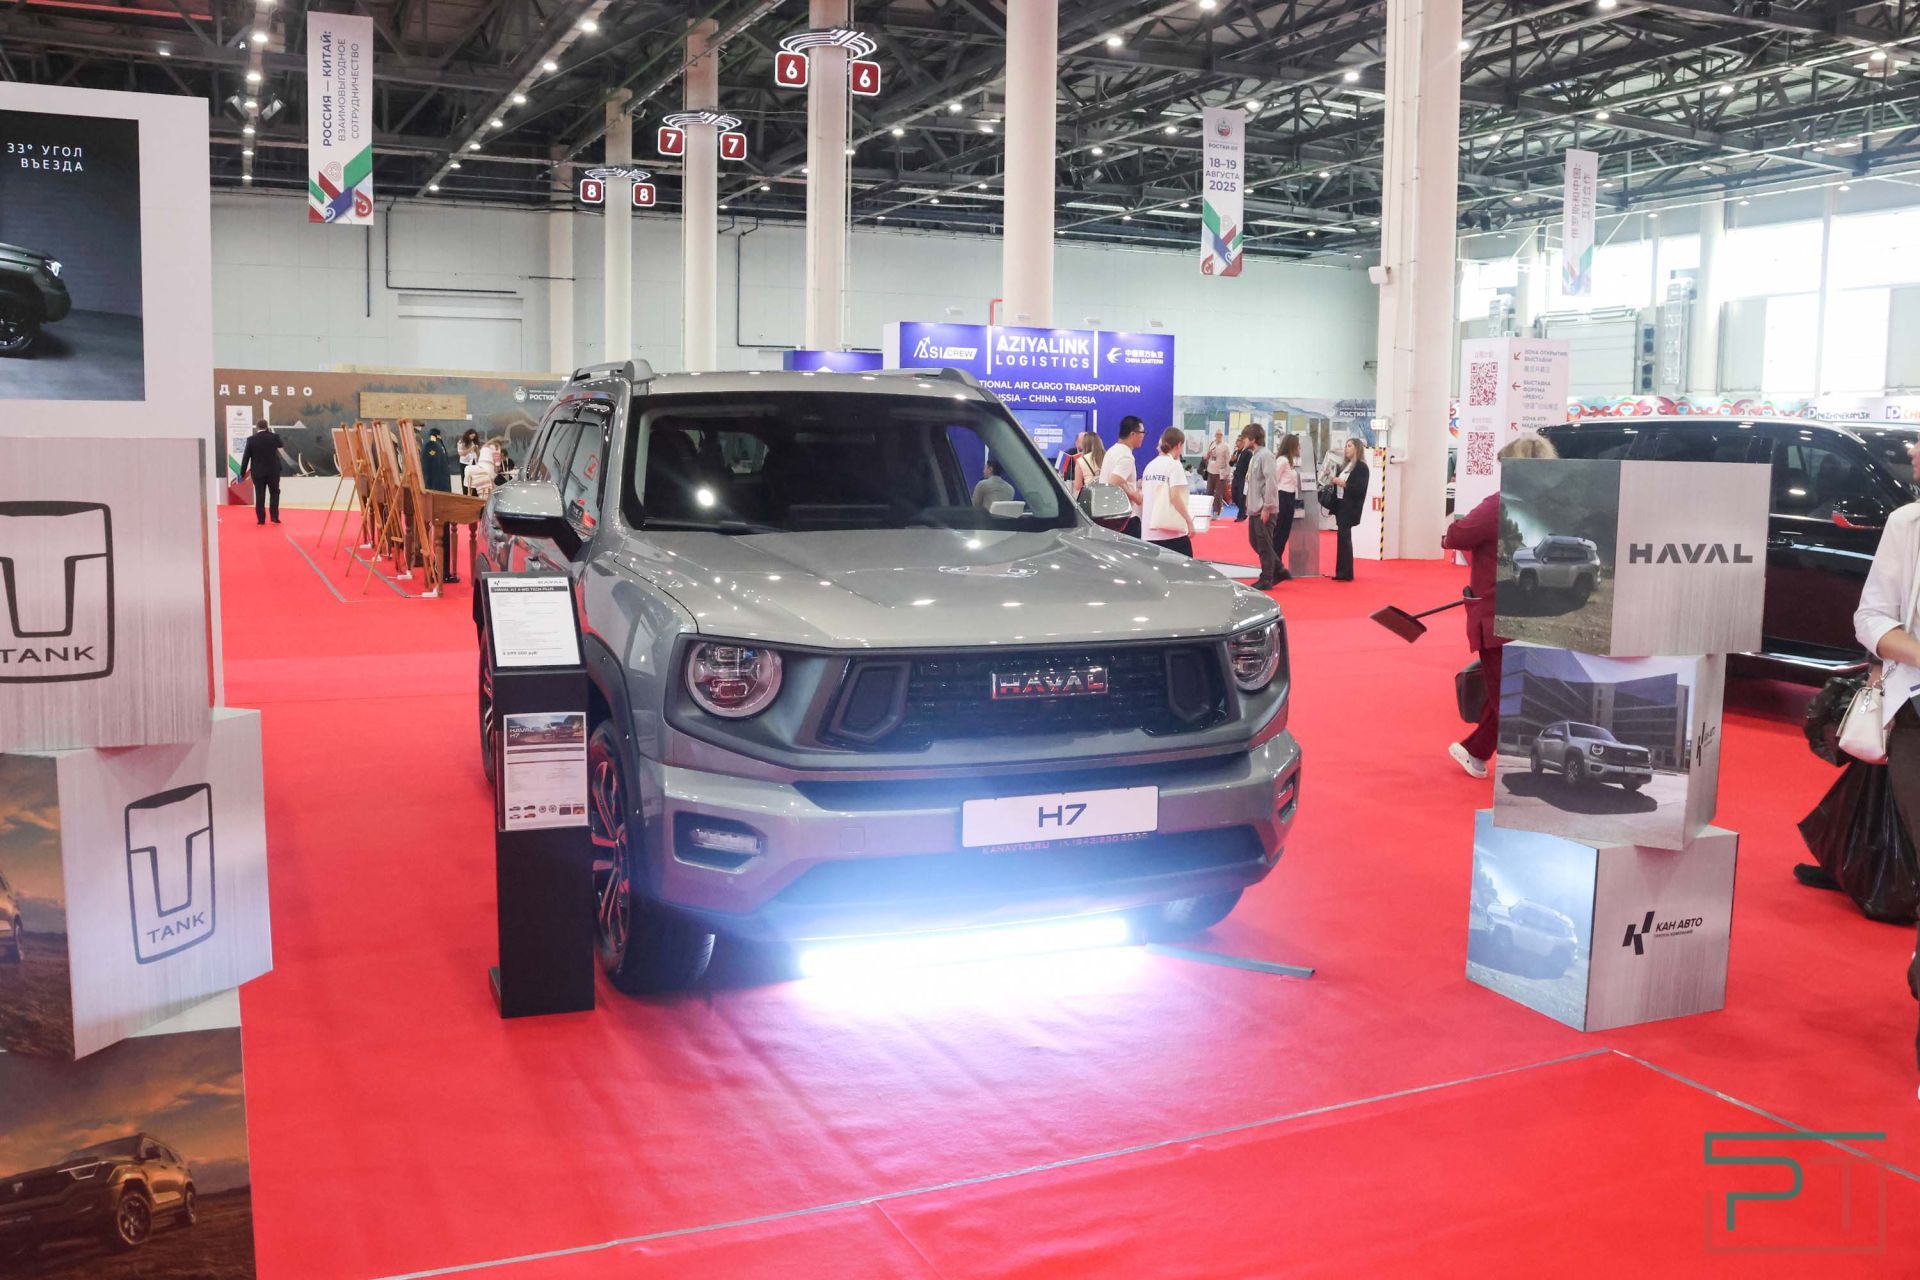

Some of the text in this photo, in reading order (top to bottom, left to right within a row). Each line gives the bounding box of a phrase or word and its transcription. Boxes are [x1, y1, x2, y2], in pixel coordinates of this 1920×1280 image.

[321, 31, 332, 77] КИТАЙ:
[785, 59, 798, 79] 6
[859, 68, 871, 88] 6
[337, 39, 346, 142] ВЗАИМОВЫГОДНОЕ
[351, 43, 360, 139] СОТРУДНИЧЕСТВО
[322, 95, 332, 147] РОССИЯ
[666, 132, 677, 149] 7
[728, 138, 739, 154] 7
[7, 142, 82, 157] 33° УГОЛ
[20, 158, 83, 173] ВЪЕЗДА
[1205, 170, 1240, 180] АВГУСТА
[587, 184, 597, 198] 8
[639, 188, 649, 202] 8
[1209, 180, 1237, 193] 2025
[996, 336, 1090, 355] AZIYALINK
[995, 355, 1090, 369] LOGISTICS
[219, 384, 313, 397] ДЕРЕВО
[1014, 382, 1030, 390] AIR
[1031, 382, 1063, 391] CARGO
[1064, 382, 1141, 393] TRANSPORTATION
[1029, 394, 1057, 403] CHINA
[1065, 395, 1096, 404] RUSSIA
[1629, 543, 1753, 564] HAVAL
[0, 646, 95, 663] TANK
[1000, 675, 1104, 694] HAVAL
[1038, 803, 1087, 828] H7
[146, 911, 205, 945] TANK
[1655, 917, 1703, 933] КАН АВТО
